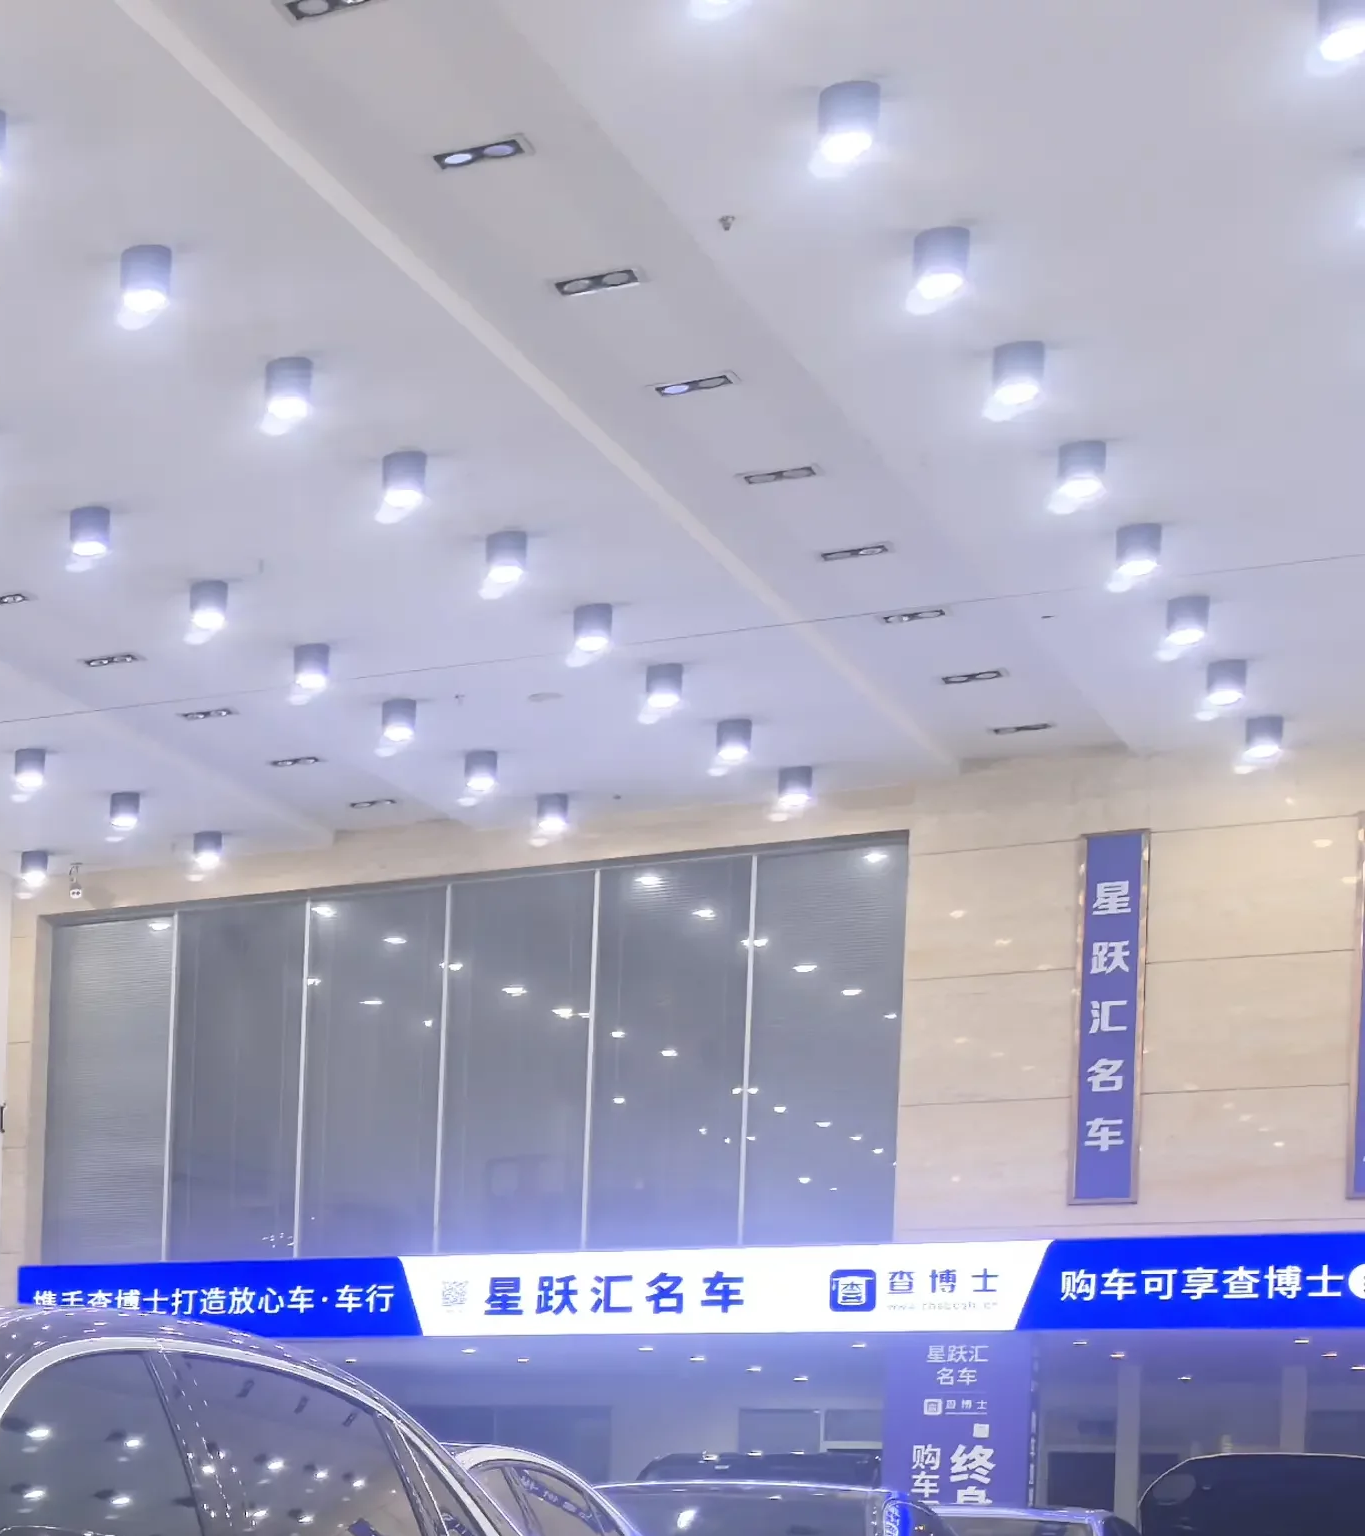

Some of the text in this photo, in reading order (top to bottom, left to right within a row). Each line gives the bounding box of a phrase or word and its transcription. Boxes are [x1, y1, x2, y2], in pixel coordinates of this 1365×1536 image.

[1084, 881, 1131, 1151] 星跃汇名车
[484, 1271, 744, 1316] 星跃汇名车
[887, 1268, 999, 1295] 查博士
[1060, 1264, 1344, 1301] 购车可享查博士
[926, 1345, 989, 1363] 星跃汇
[936, 1367, 977, 1386] 名车
[911, 1444, 941, 1504] 购车
